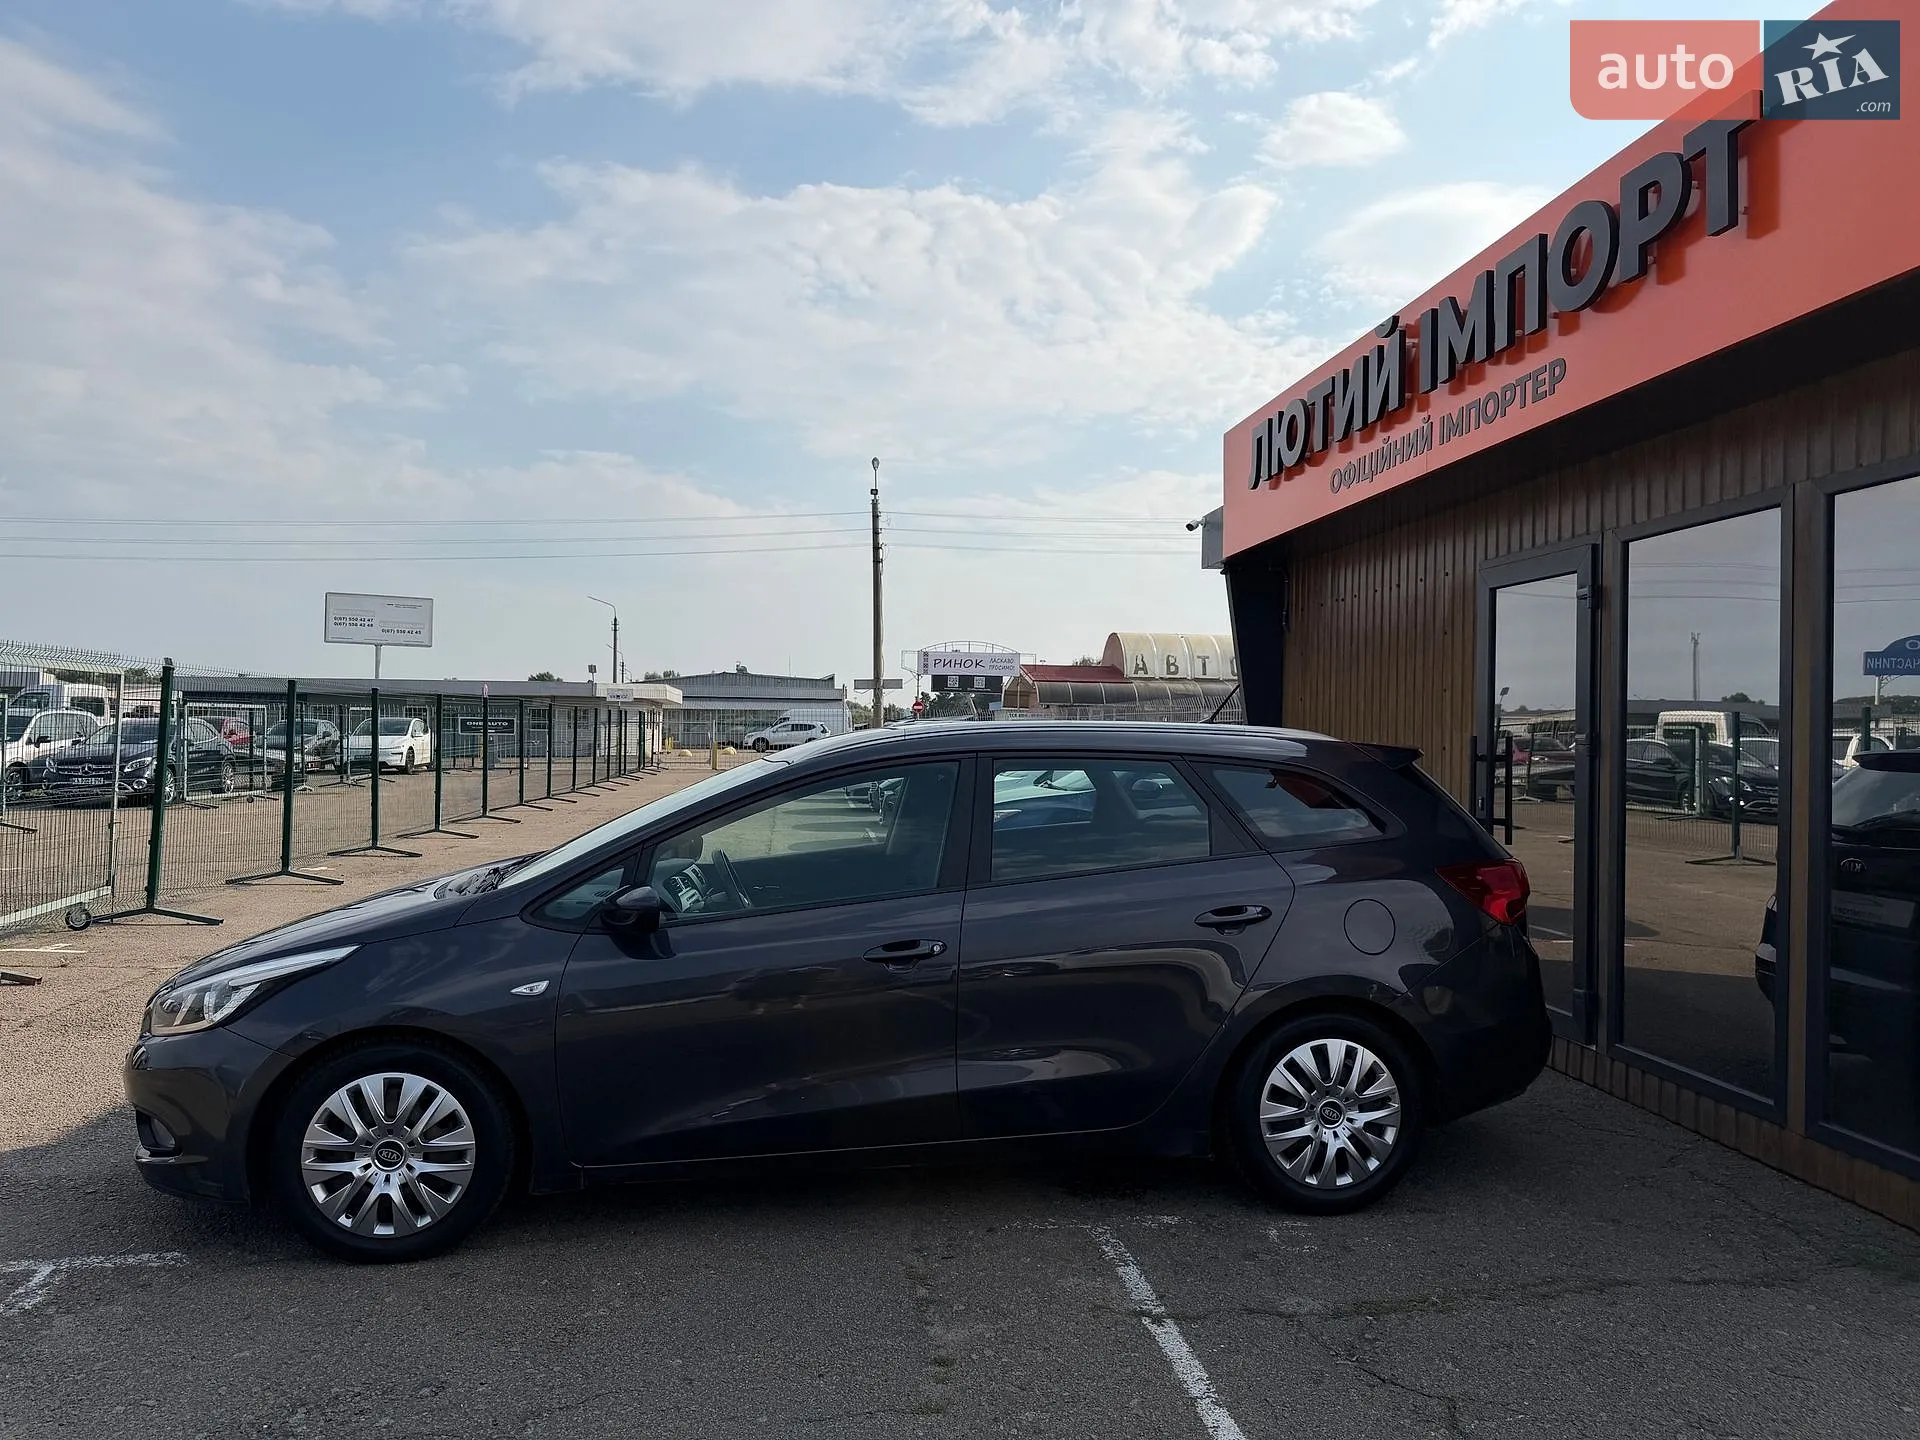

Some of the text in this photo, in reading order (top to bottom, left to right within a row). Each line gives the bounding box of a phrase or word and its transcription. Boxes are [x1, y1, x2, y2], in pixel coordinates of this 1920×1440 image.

[1248, 90, 1762, 490] ЛЮТИЙ ІМПОРТ
[1329, 357, 1567, 494] ОФІЦІЙНИЙ ІМПОРТЕР
[933, 658, 986, 669] РИНОК
[381, 1150, 398, 1160] KIA
